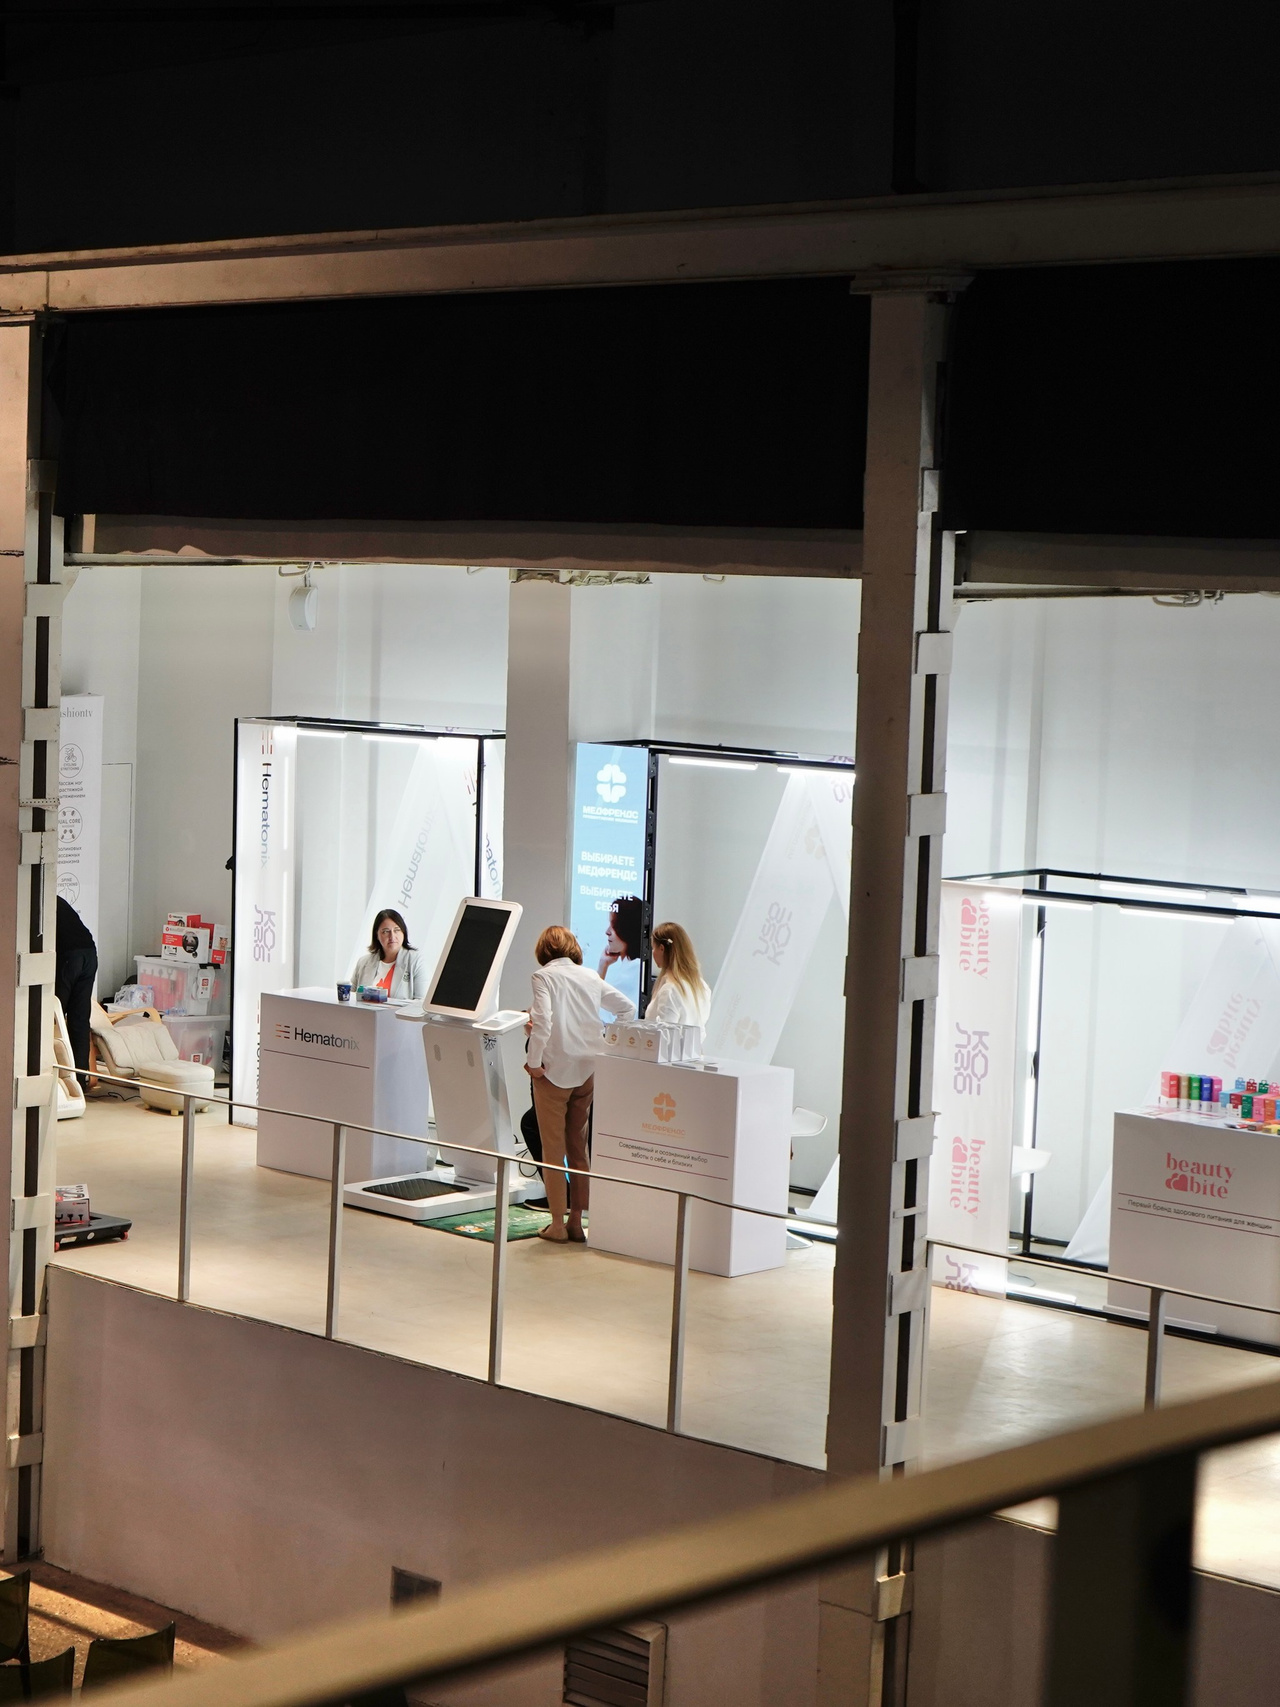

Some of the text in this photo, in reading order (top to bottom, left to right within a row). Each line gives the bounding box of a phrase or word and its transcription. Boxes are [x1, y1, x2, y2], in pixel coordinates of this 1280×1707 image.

[261, 762, 273, 870] Hematonix
[582, 805, 639, 820] МЕДФРЕНДС
[581, 850, 635, 867] ВЫБИРАЕТЕ
[577, 864, 638, 882] МЕДФРЕНДС
[580, 885, 634, 902] ВЫБИРАЕТЕ
[594, 900, 619, 913] СЕБЯ
[294, 1026, 360, 1052] Hematonix
[618, 1141, 654, 1152] Современный
[1165, 1152, 1237, 1180] beauty
[948, 1168, 966, 1209] bite
[968, 1138, 987, 1219] beauty
[1190, 1176, 1229, 1199] bite
[1127, 1199, 1273, 1231] Первый бренд здорового питания для женщин
